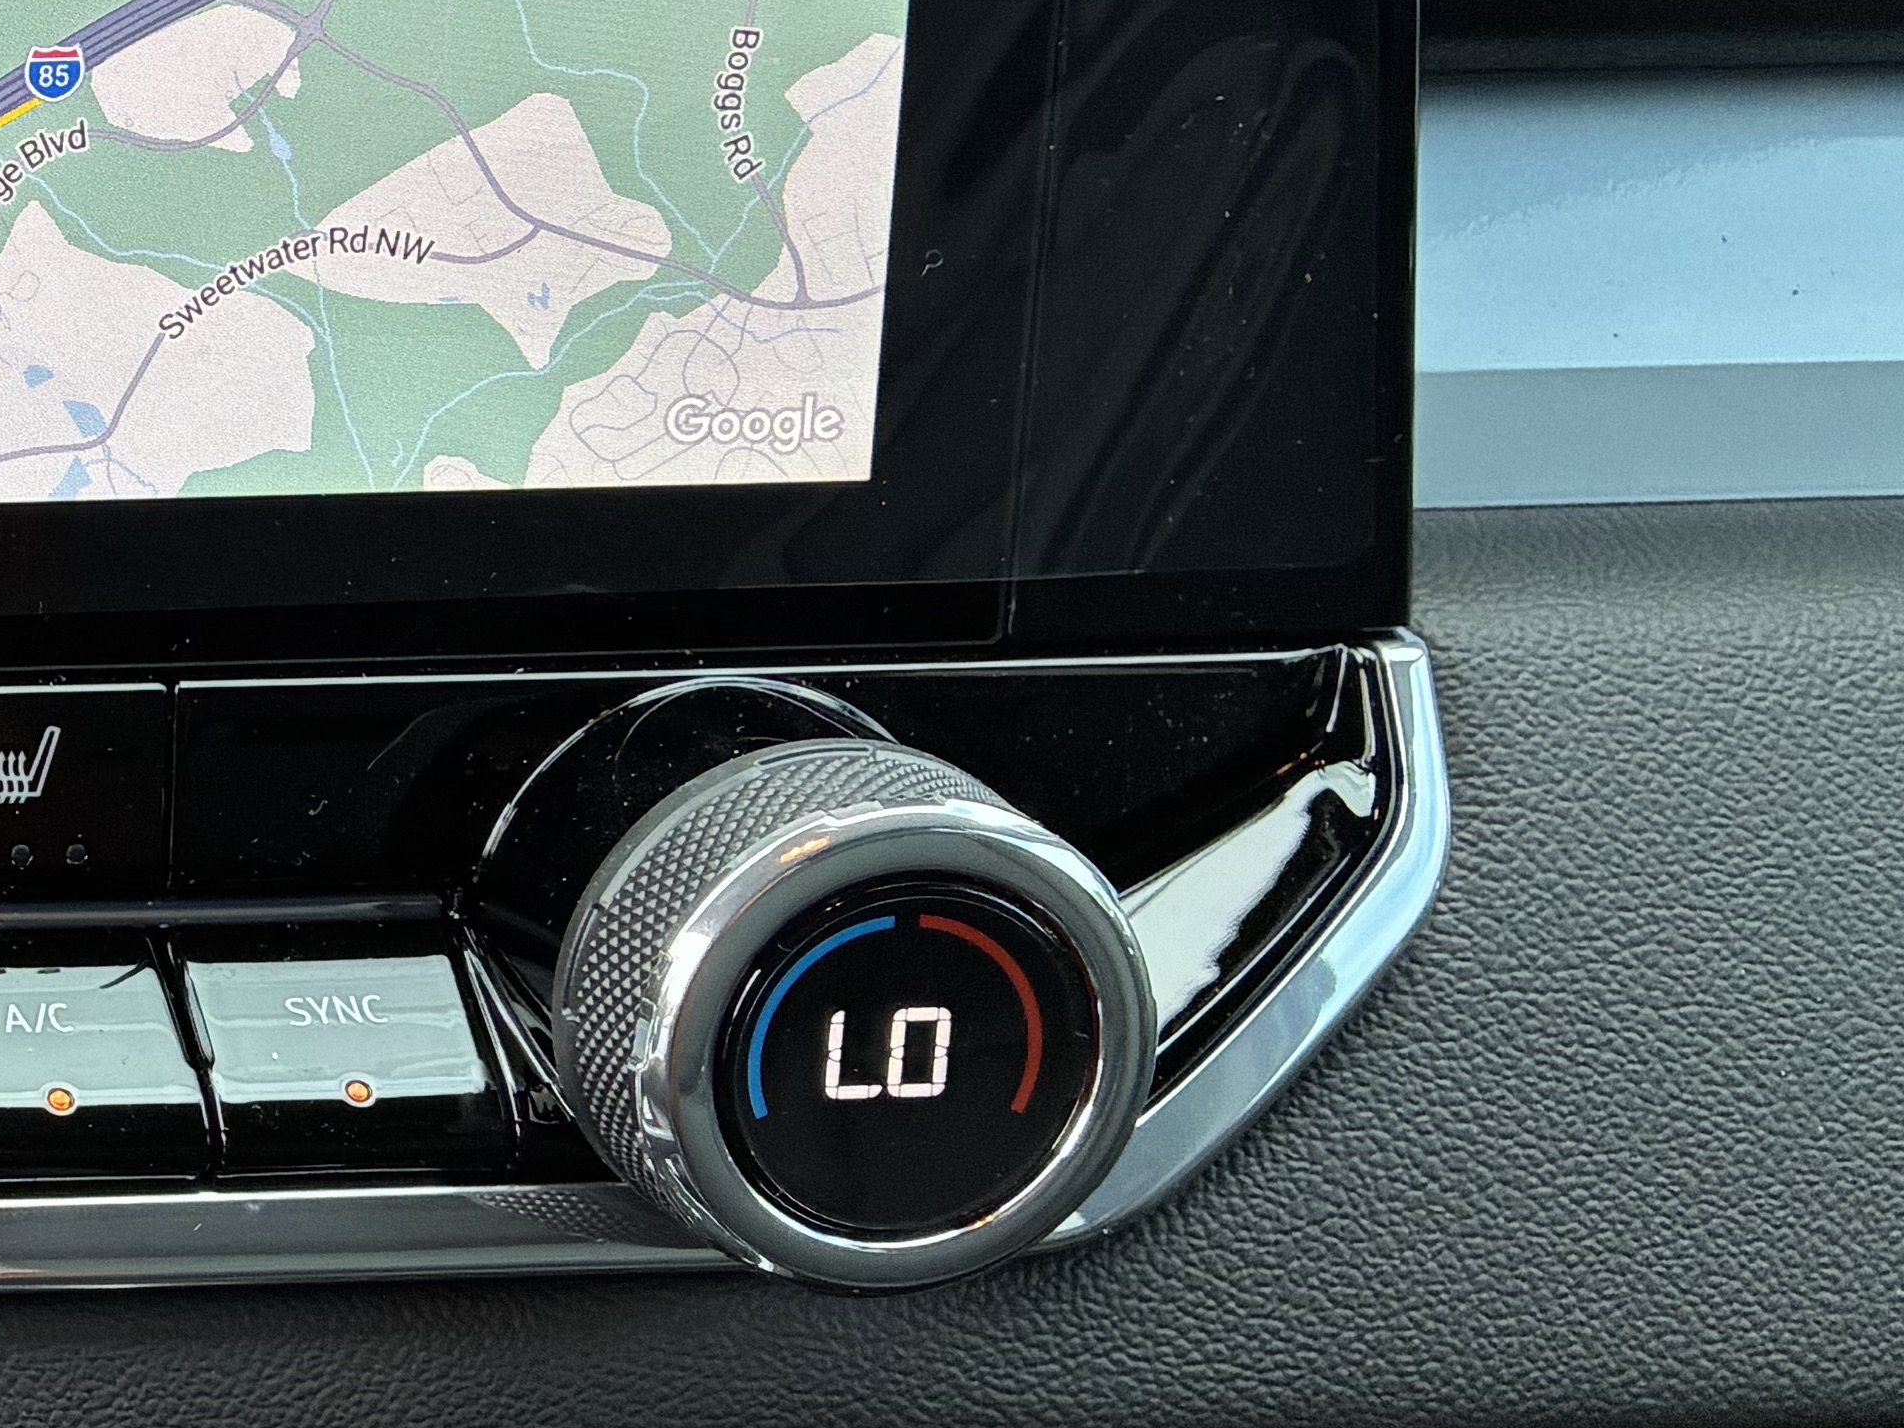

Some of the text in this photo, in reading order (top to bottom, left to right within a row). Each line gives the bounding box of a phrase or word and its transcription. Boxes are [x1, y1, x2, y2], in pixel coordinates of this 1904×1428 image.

[39, 64, 68, 86] 85
[715, 28, 759, 181] Boggs Rd
[20, 121, 88, 171] Blvd
[159, 227, 436, 341] Sweetwater Rd NW
[664, 395, 844, 453] Google
[5, 1003, 76, 1035] A/C
[285, 994, 390, 1028] SYNC
